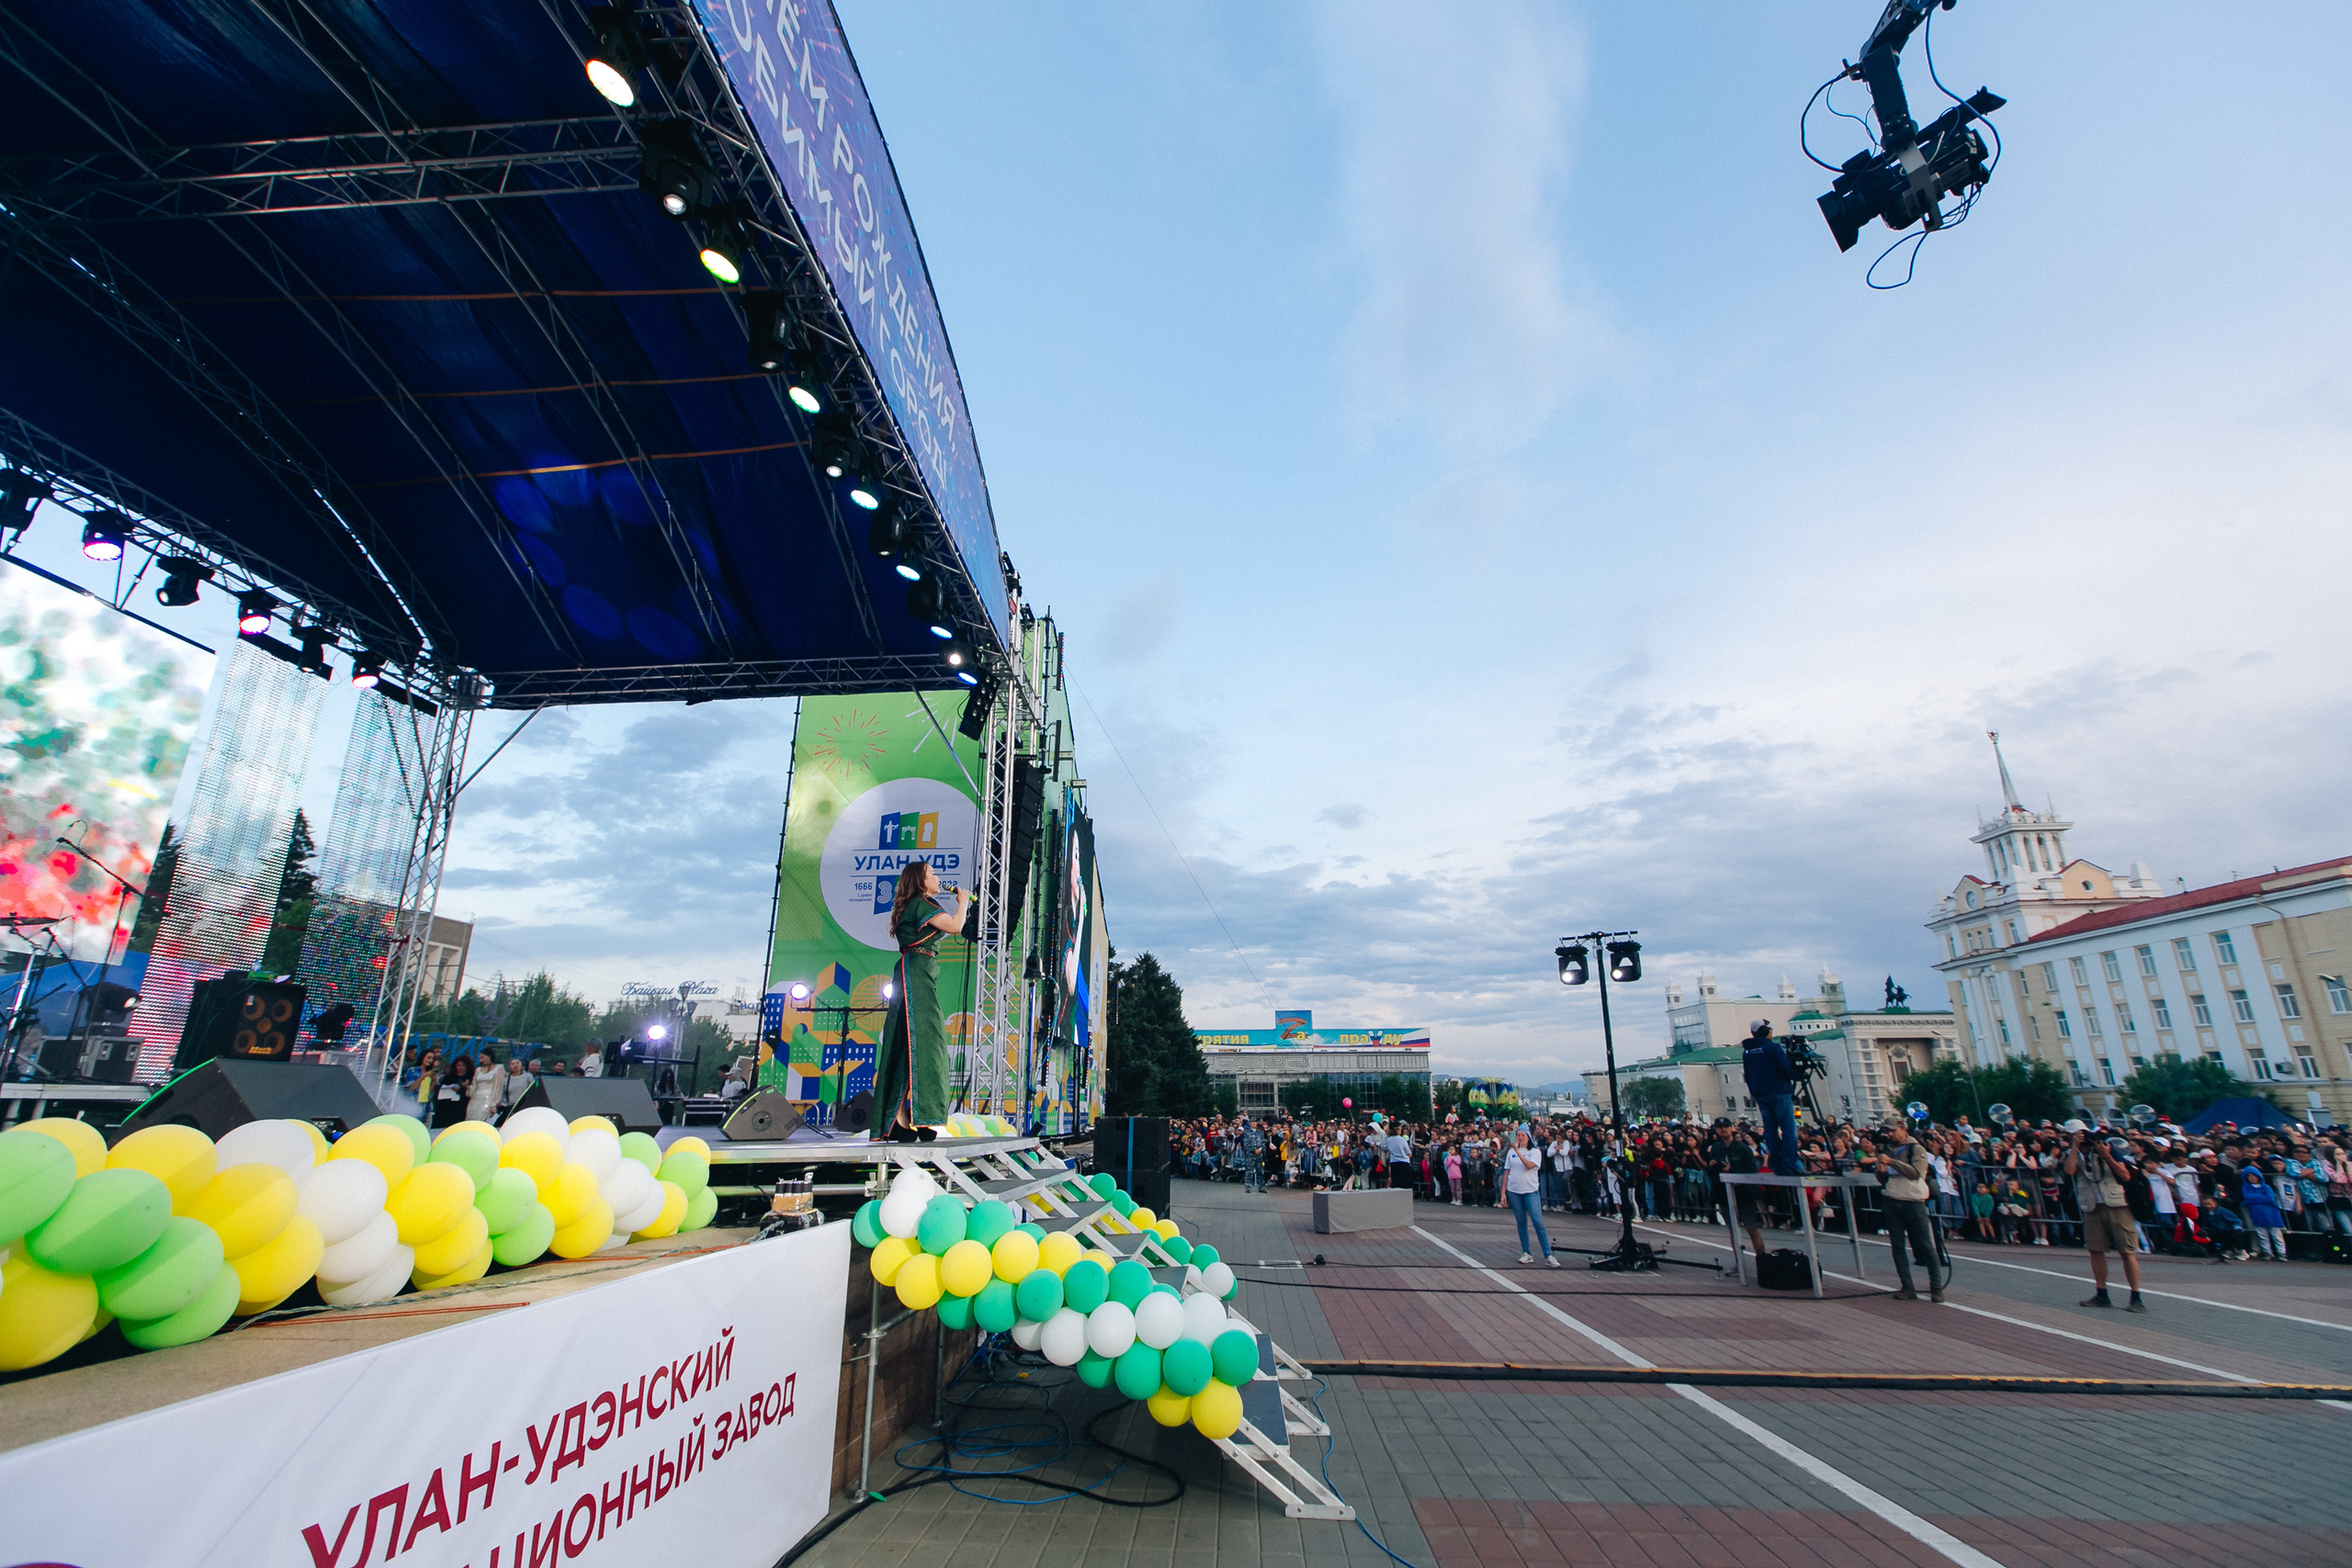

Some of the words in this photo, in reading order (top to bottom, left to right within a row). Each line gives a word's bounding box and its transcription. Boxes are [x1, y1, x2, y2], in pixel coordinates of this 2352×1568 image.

[766, 0, 829, 132] ЁМ
[879, 313, 947, 491] ГОРОД
[854, 853, 960, 872] УЛАНУДЭ
[854, 882, 873, 890] 1666
[621, 981, 674, 995] Байкал
[1197, 1034, 1250, 1047] рятия
[711, 1372, 797, 1460] ЗАВОД
[301, 1325, 735, 1568] УЛАН-УДЭНСКИЙ
